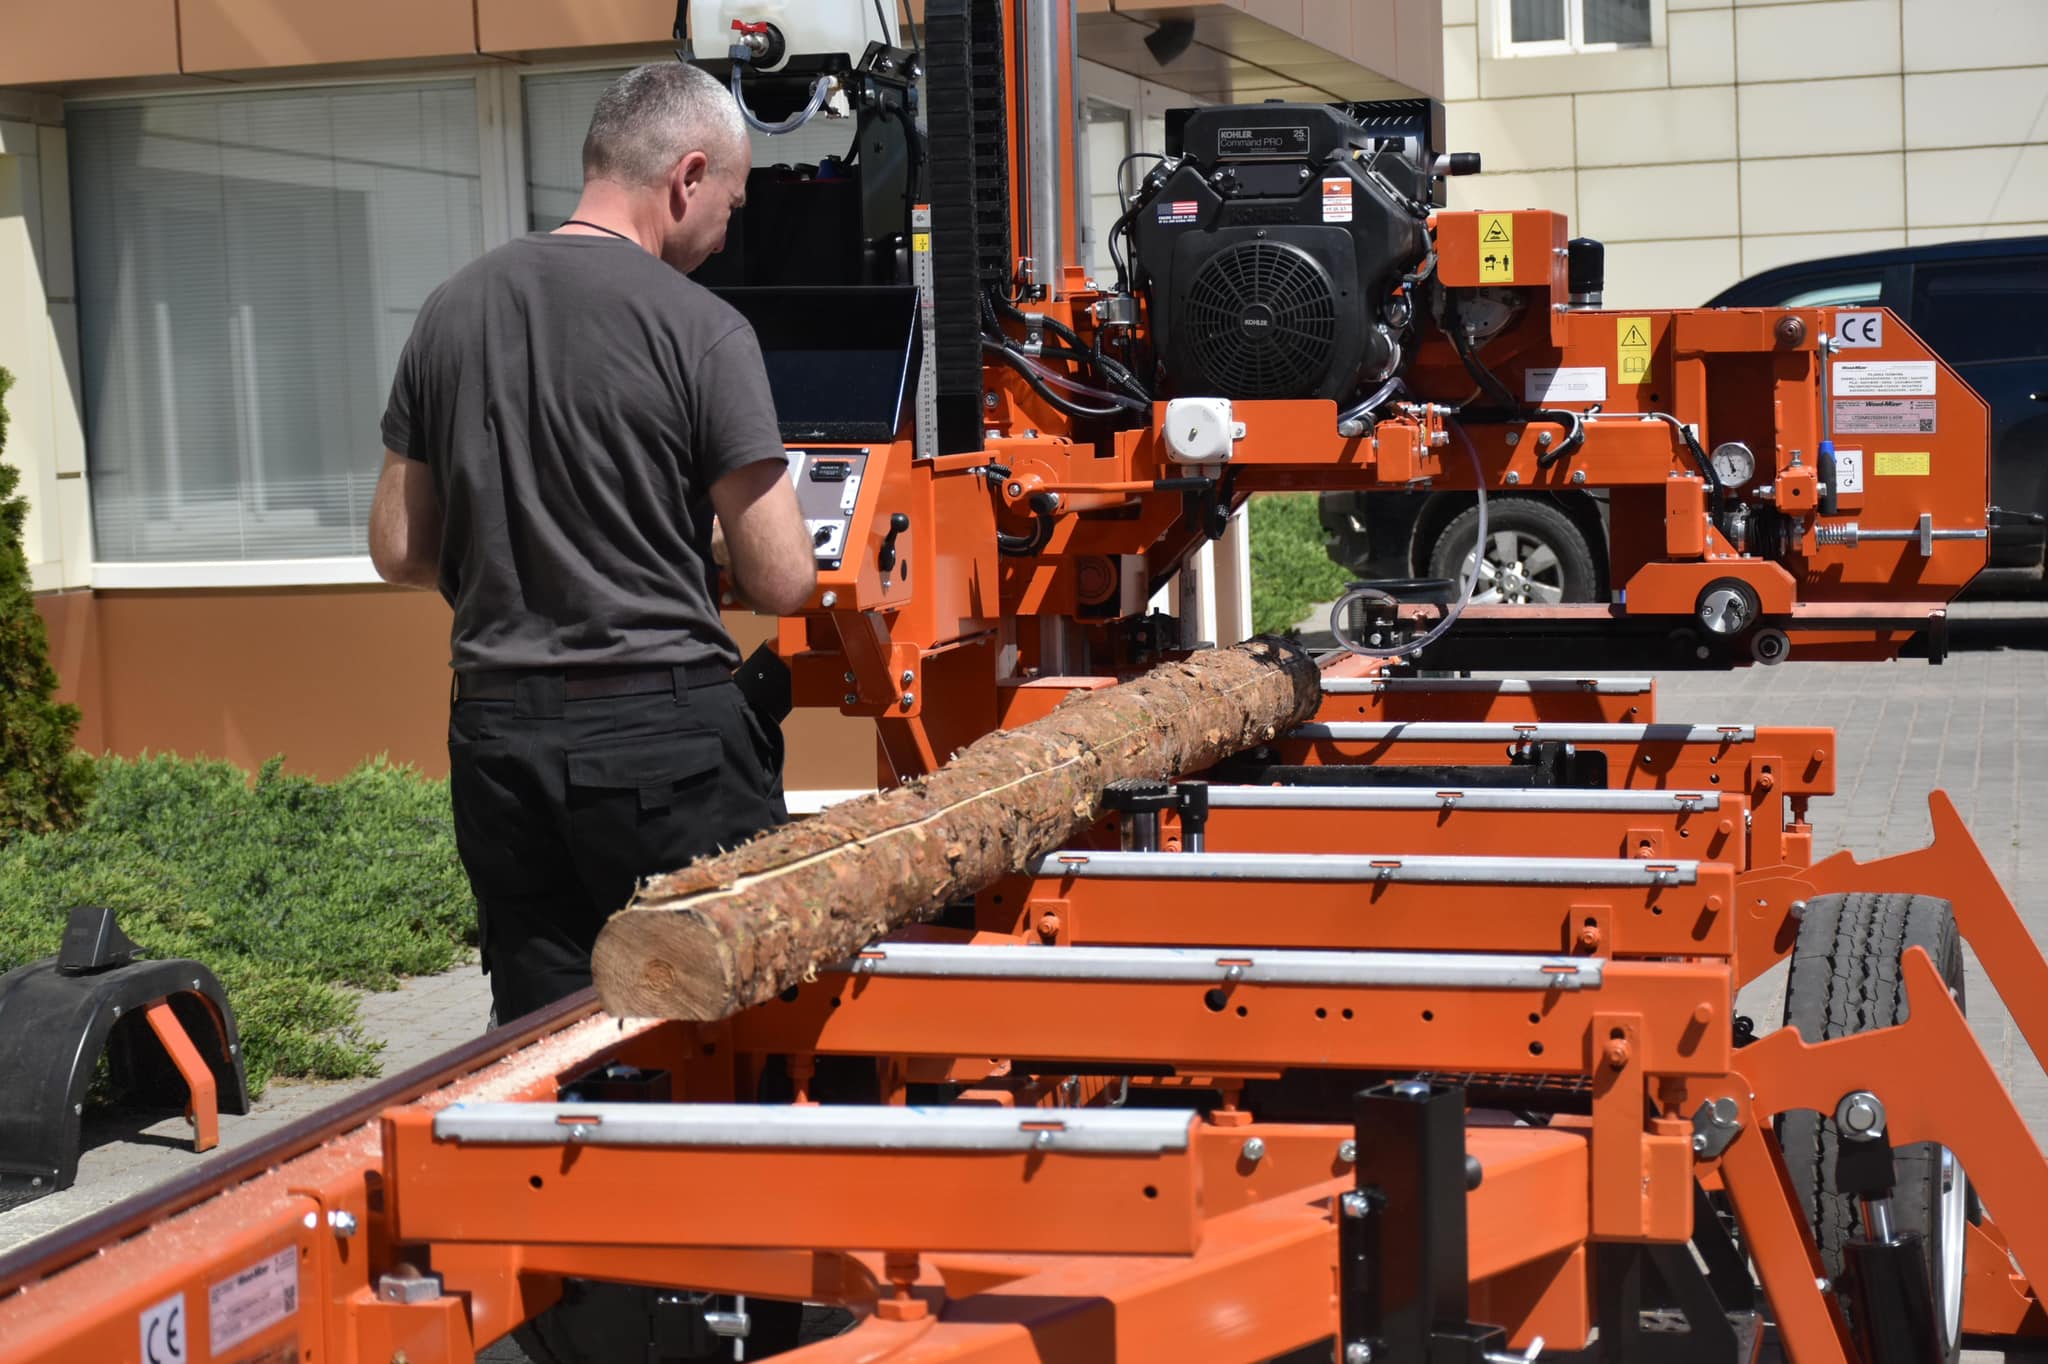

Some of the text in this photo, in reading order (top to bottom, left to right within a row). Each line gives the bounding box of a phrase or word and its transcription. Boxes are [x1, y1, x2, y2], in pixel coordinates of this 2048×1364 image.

[1221, 129, 1305, 139] KOHLER 25
[1220, 137, 1283, 148] Command PRO
[1842, 318, 1876, 343] CE
